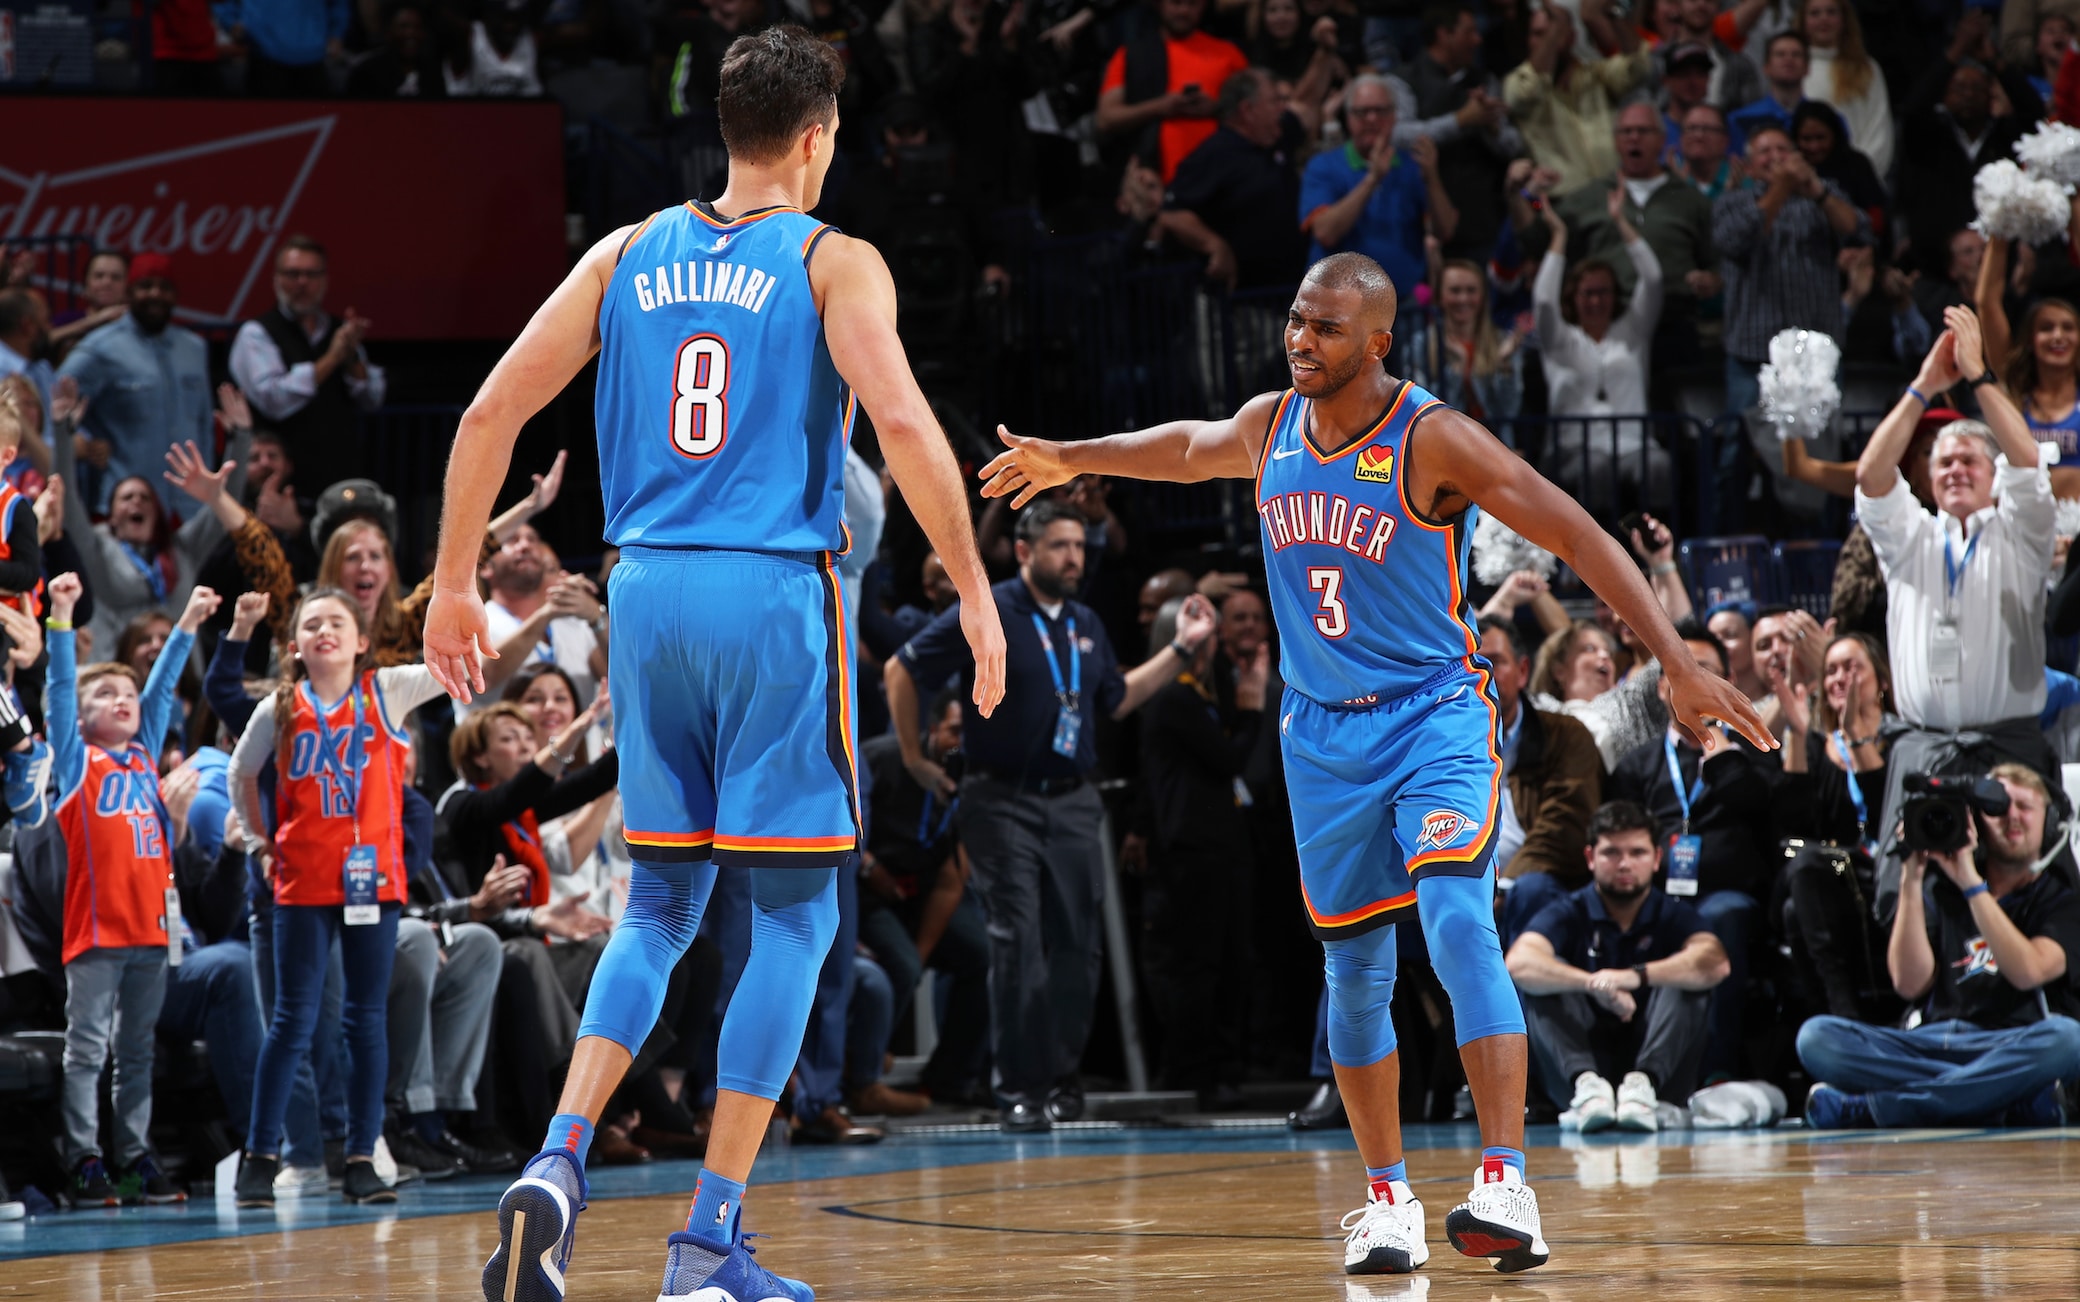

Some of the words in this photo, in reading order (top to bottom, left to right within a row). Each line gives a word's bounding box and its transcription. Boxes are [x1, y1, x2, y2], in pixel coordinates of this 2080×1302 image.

[634, 260, 777, 314] GALLINARI
[669, 332, 732, 460] 8
[1260, 490, 1398, 565] THUNDER
[1307, 566, 1350, 640] 3
[287, 723, 376, 780] OKC
[95, 768, 159, 817] OK
[315, 774, 355, 818] 12
[126, 815, 161, 859] 12
[1421, 817, 1457, 844] OKC
